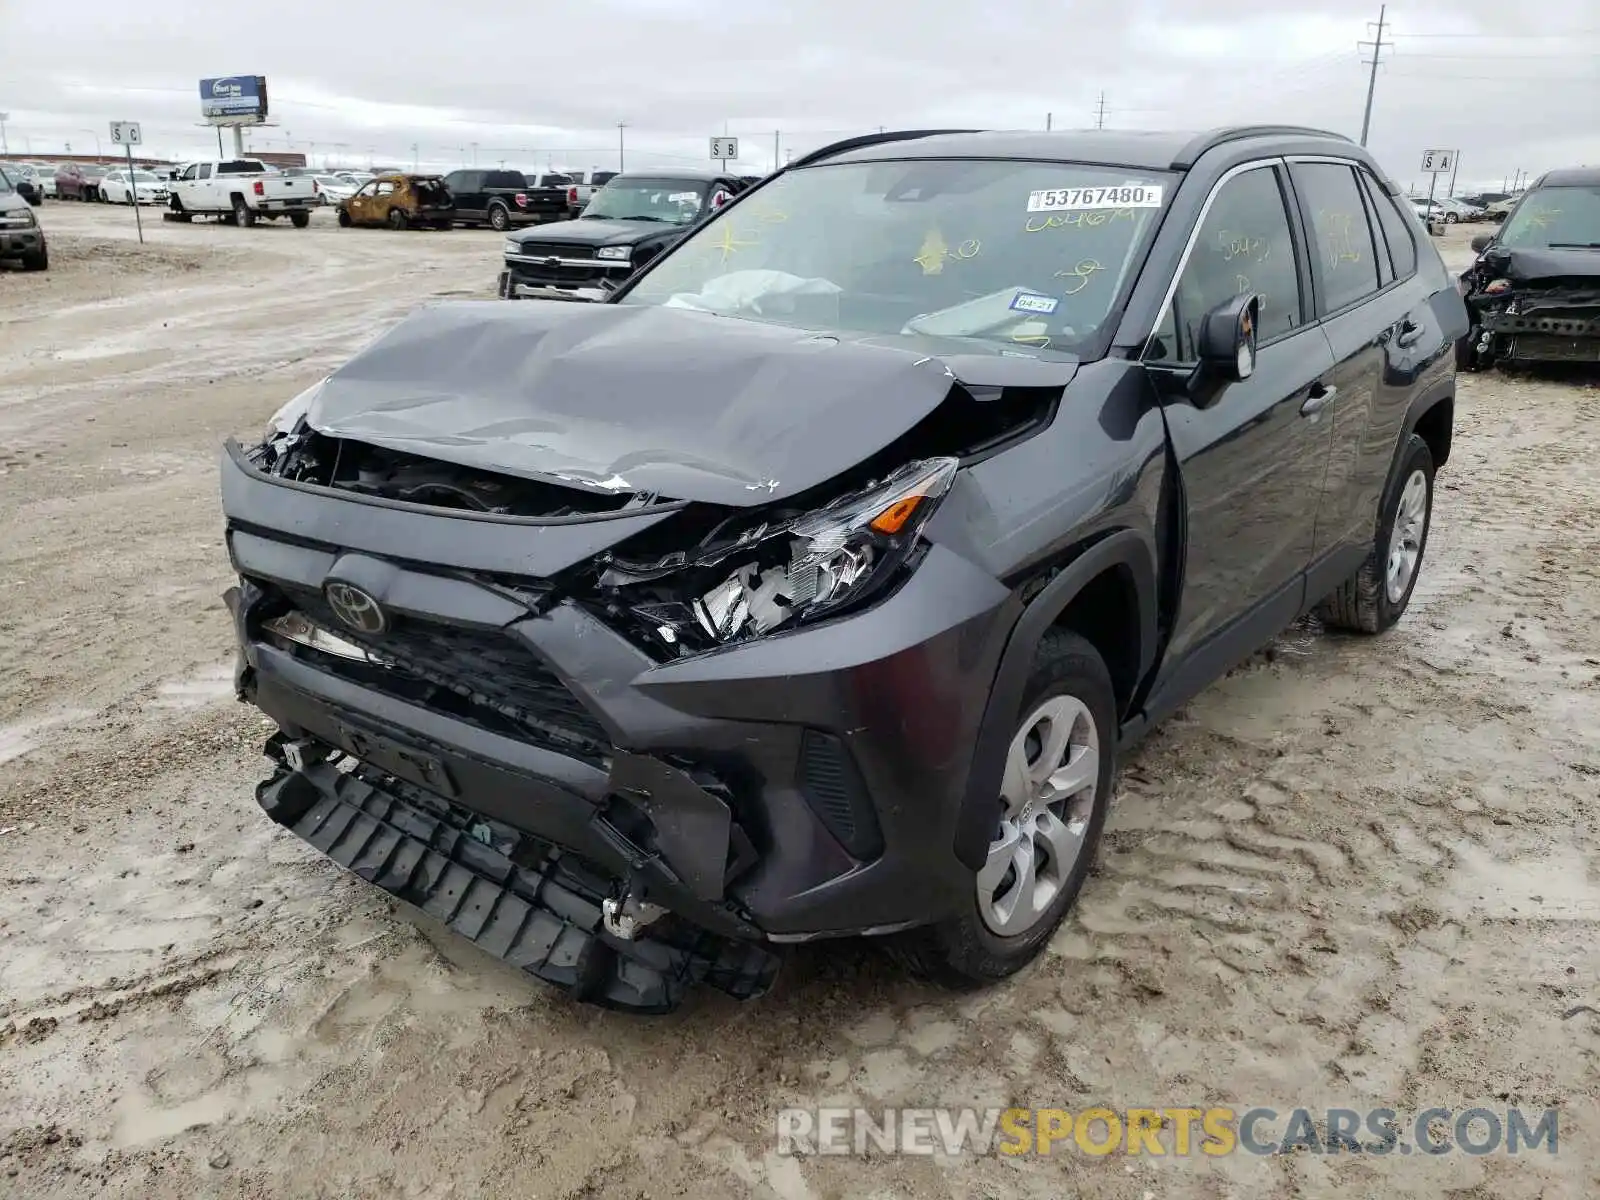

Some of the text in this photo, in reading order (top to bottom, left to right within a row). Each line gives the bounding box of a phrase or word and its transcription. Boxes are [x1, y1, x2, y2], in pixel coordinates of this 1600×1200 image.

[114, 128, 137, 141] S C
[713, 143, 734, 156] S B
[1425, 156, 1448, 169] S A
[1044, 187, 1145, 206] 53767480
